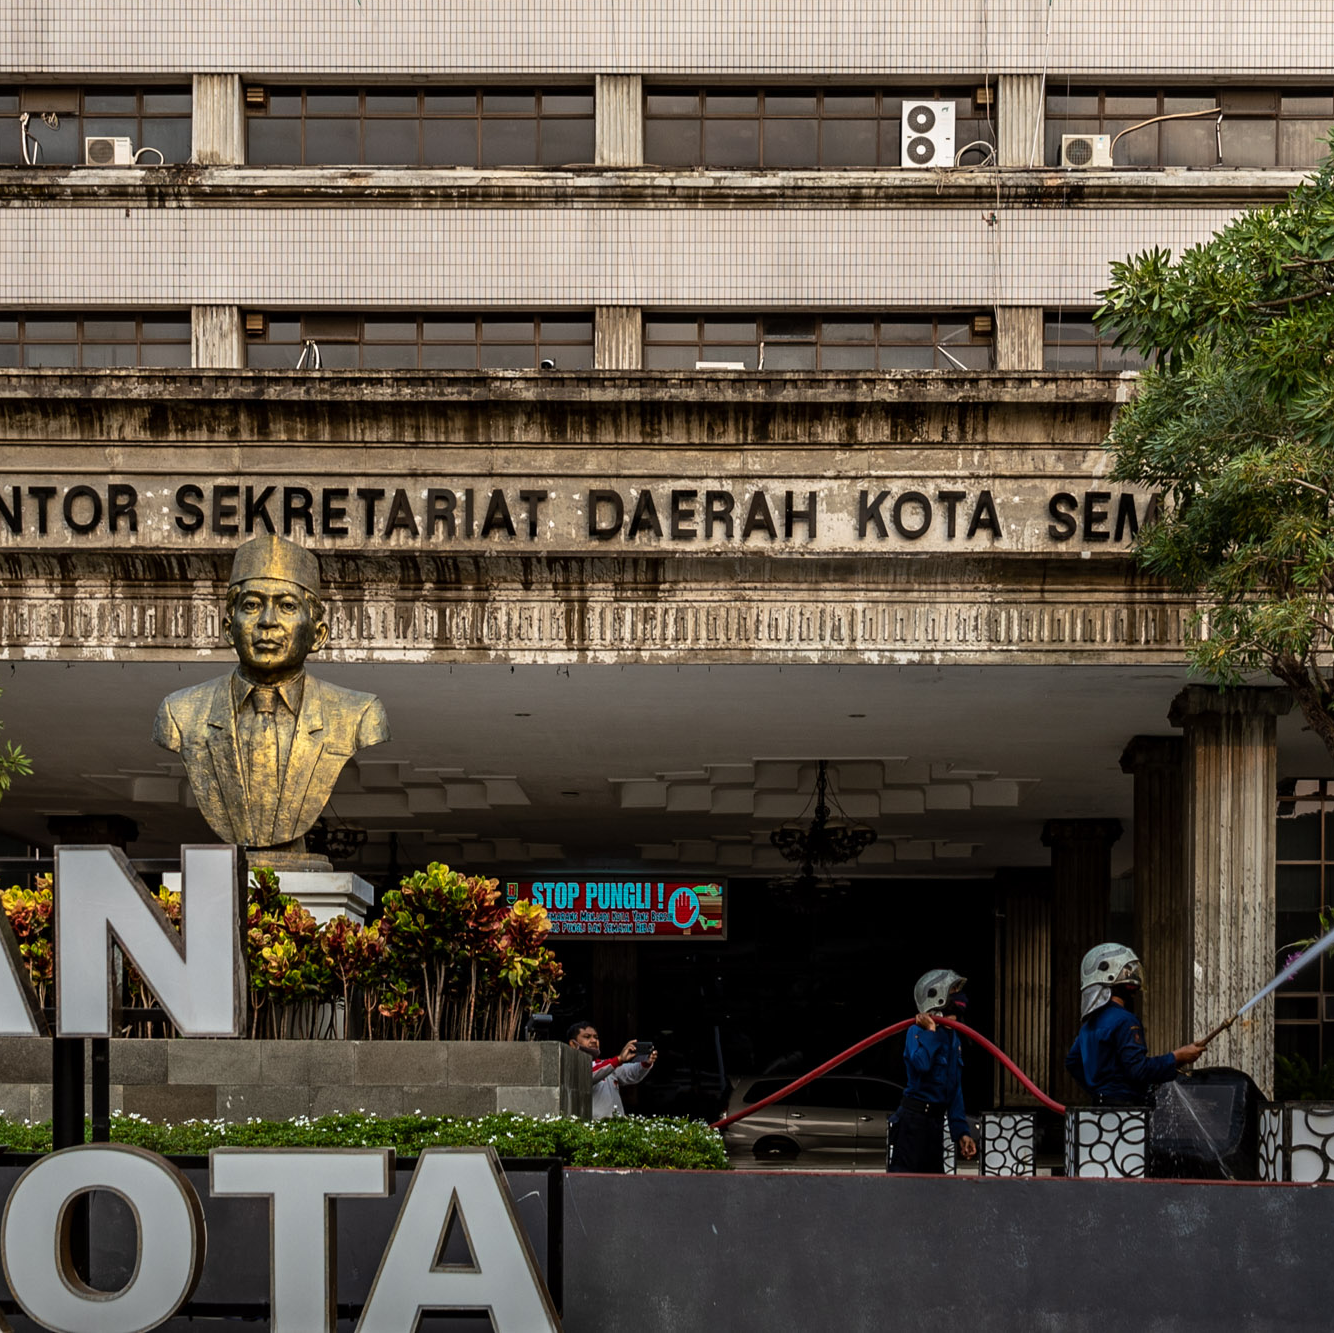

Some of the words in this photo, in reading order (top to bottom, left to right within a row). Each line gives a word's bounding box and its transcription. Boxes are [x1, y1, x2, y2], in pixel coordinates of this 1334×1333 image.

[174, 485, 548, 537] SEKRETARIAT
[588, 489, 817, 539] DAERAH
[860, 490, 1004, 539] KOTA
[1047, 491, 1164, 542] SEM
[531, 882, 580, 909] STOP
[585, 882, 651, 909] PUNGLI
